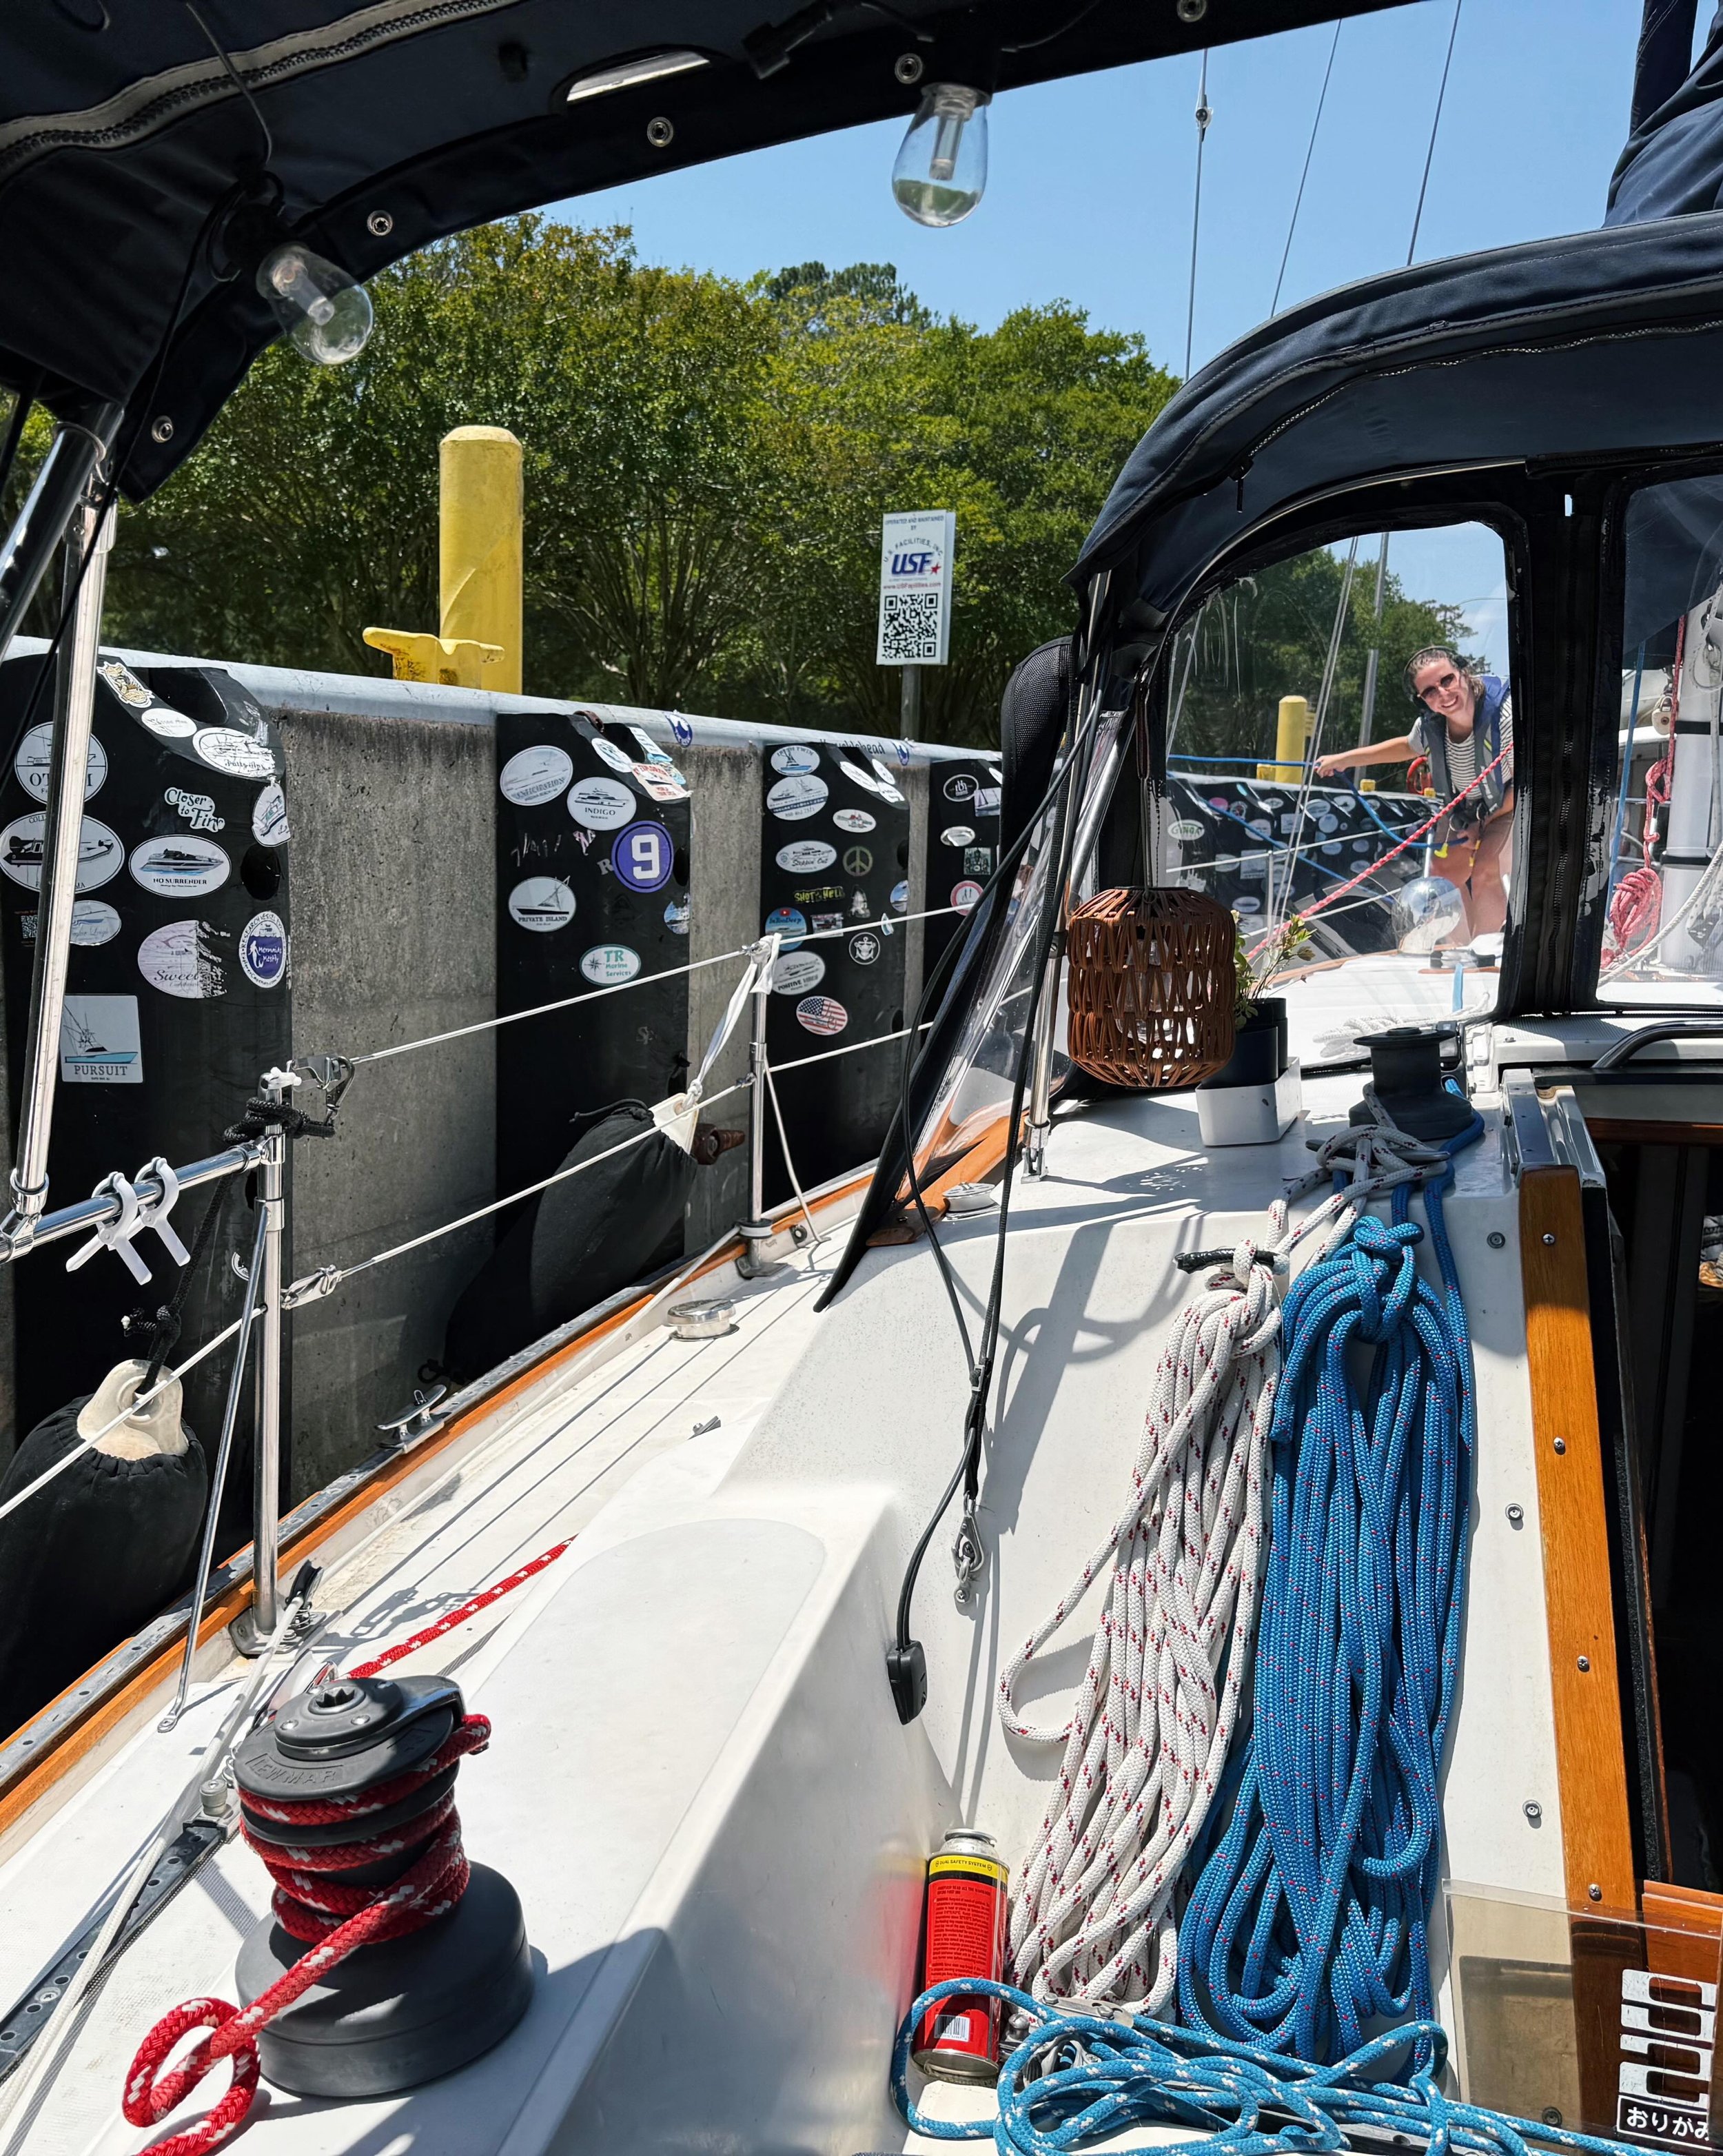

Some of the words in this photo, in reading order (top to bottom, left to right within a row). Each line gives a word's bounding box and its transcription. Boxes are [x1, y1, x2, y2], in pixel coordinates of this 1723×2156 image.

[891, 552, 933, 575] USF
[166, 789, 207, 806] Closer
[181, 805, 190, 815] to
[584, 807, 616, 816] INDIGO
[631, 834, 660, 879] 9
[604, 950, 624, 962] TR
[777, 979, 802, 991] POSITIVE
[74, 1064, 128, 1076] PURSUIT
[249, 1759, 336, 1784] LEWMAR
